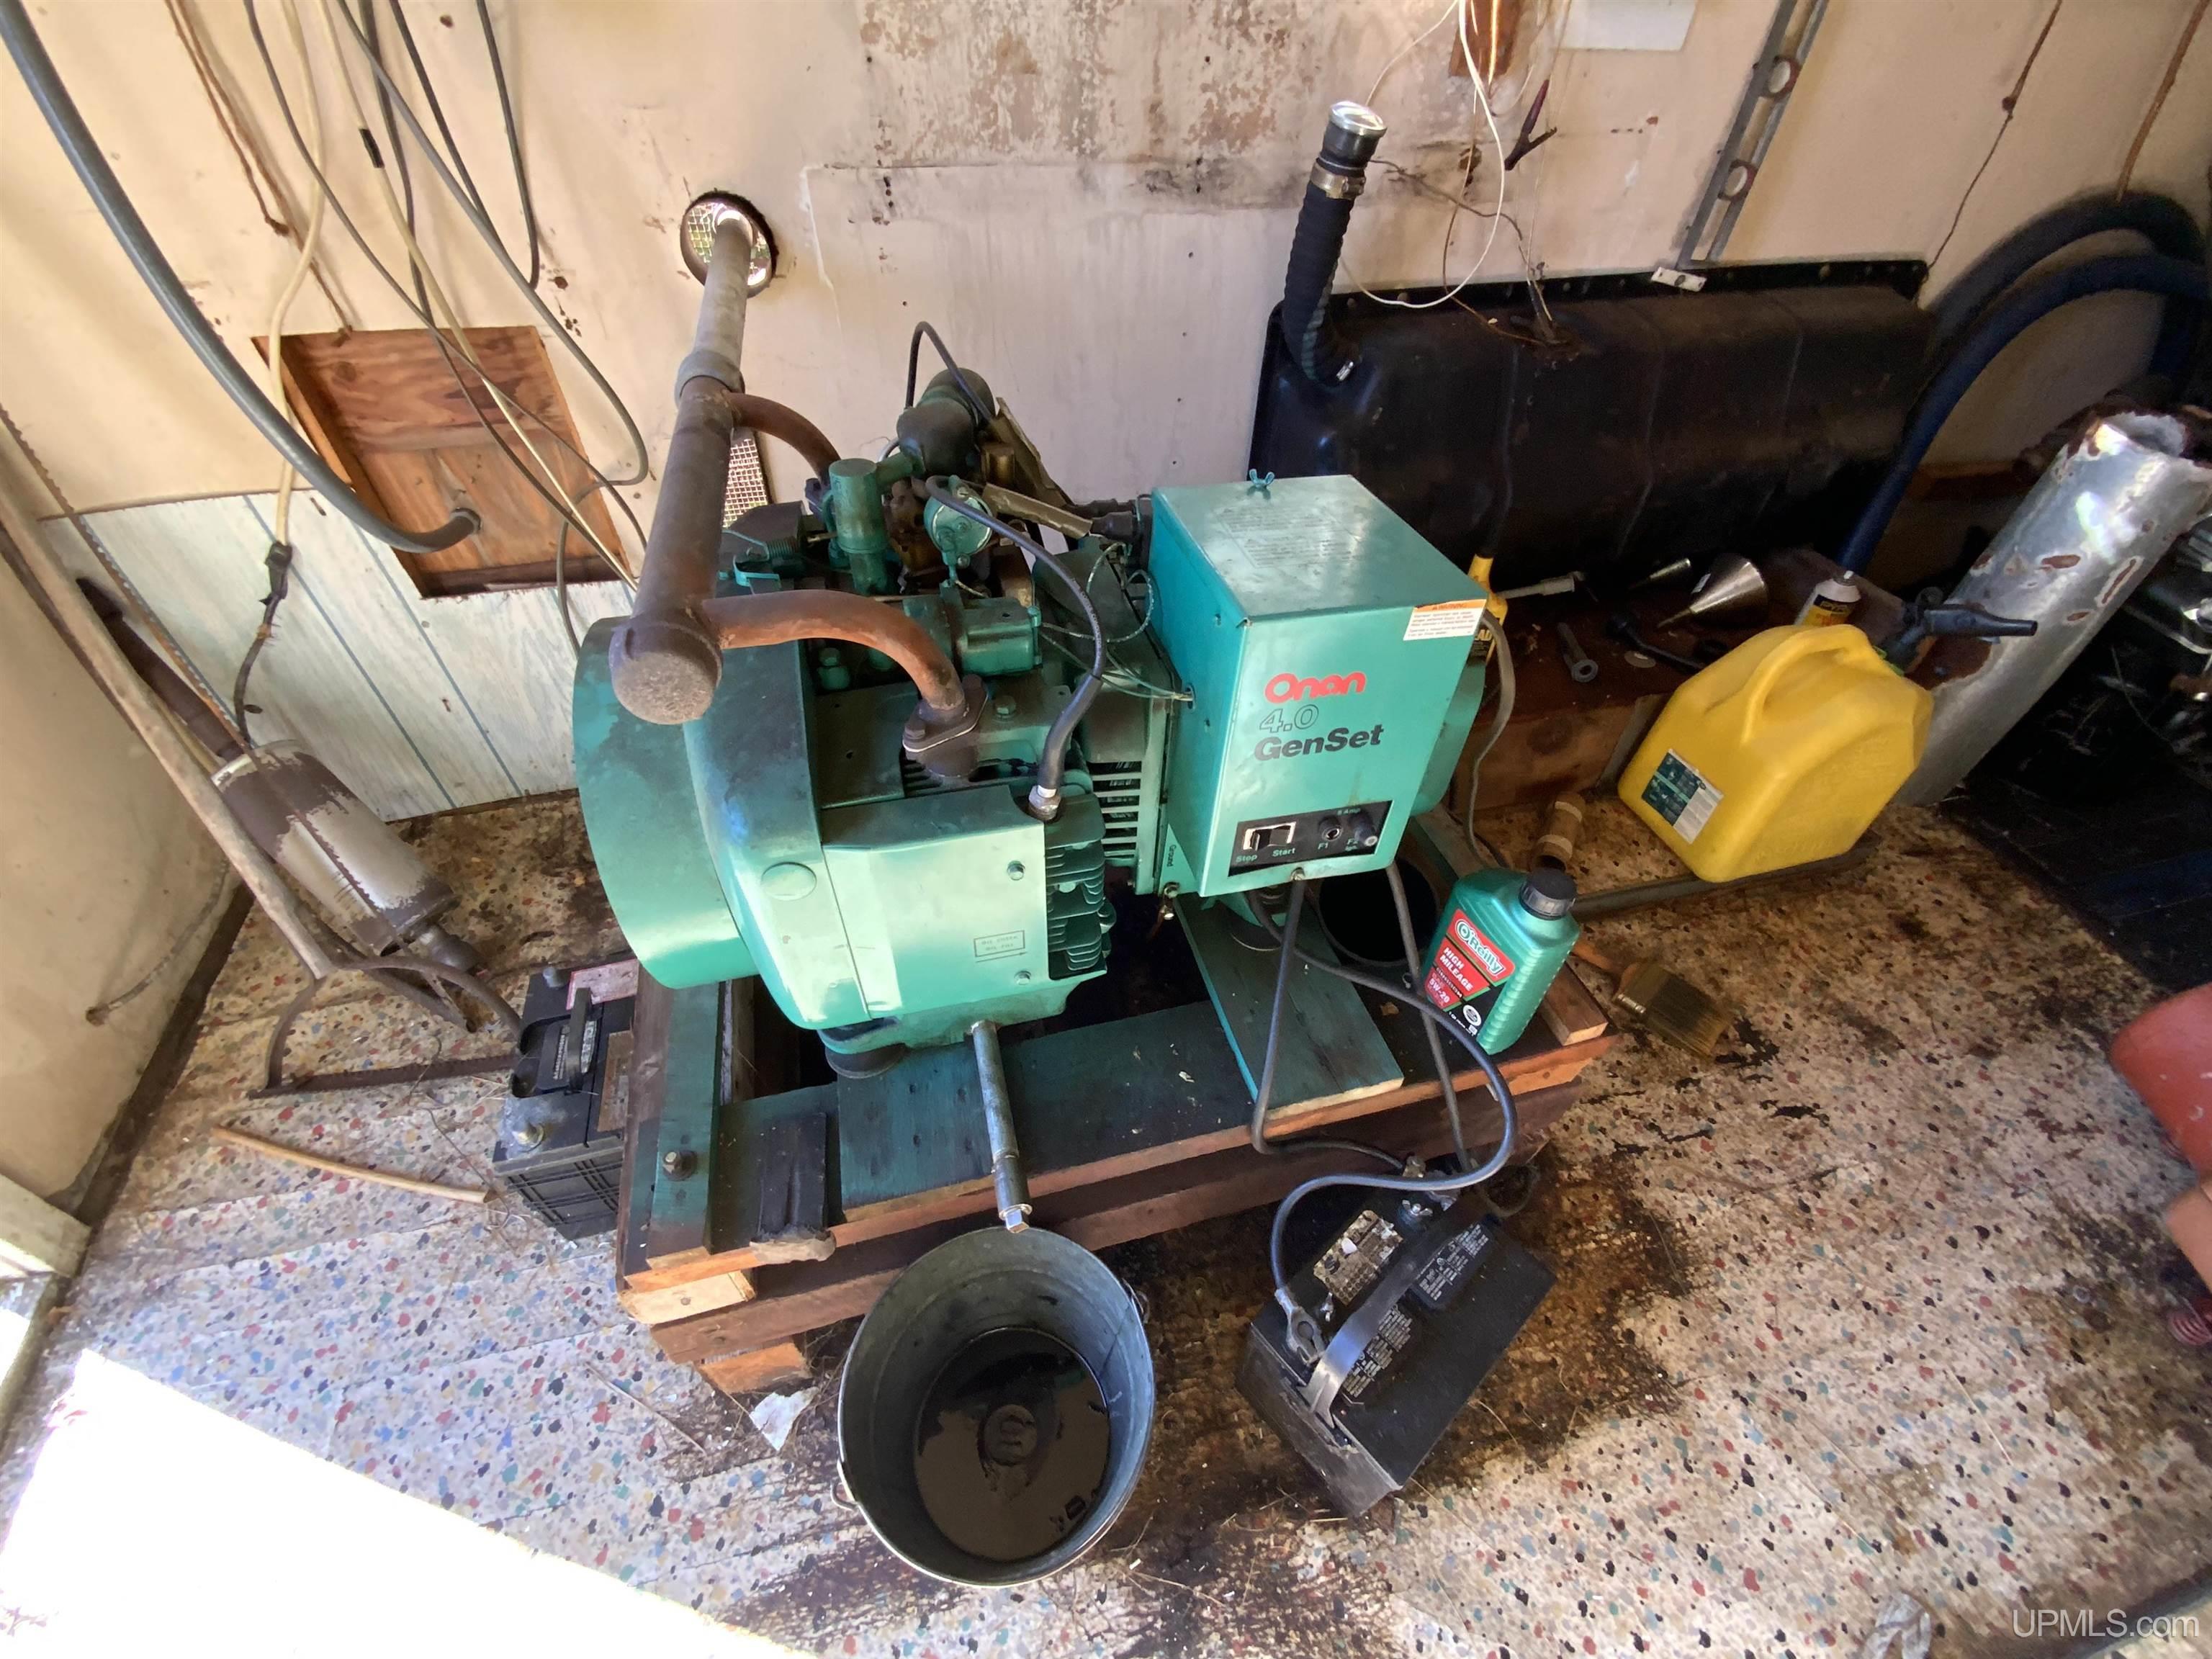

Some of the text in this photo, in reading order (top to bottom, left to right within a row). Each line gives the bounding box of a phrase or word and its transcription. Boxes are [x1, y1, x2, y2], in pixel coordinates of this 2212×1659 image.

[1264, 672, 1367, 703] Onan
[1259, 704, 1319, 733] 4.0
[1254, 724, 1384, 761] GenSet
[1236, 855, 1257, 863] Stop
[1272, 848, 1295, 857] Start
[1443, 947, 1465, 970] HIGH
[1456, 920, 1505, 974] O'Reilly
[1440, 954, 1473, 992] MILEAGE
[1429, 979, 1450, 1003] 5W-20
